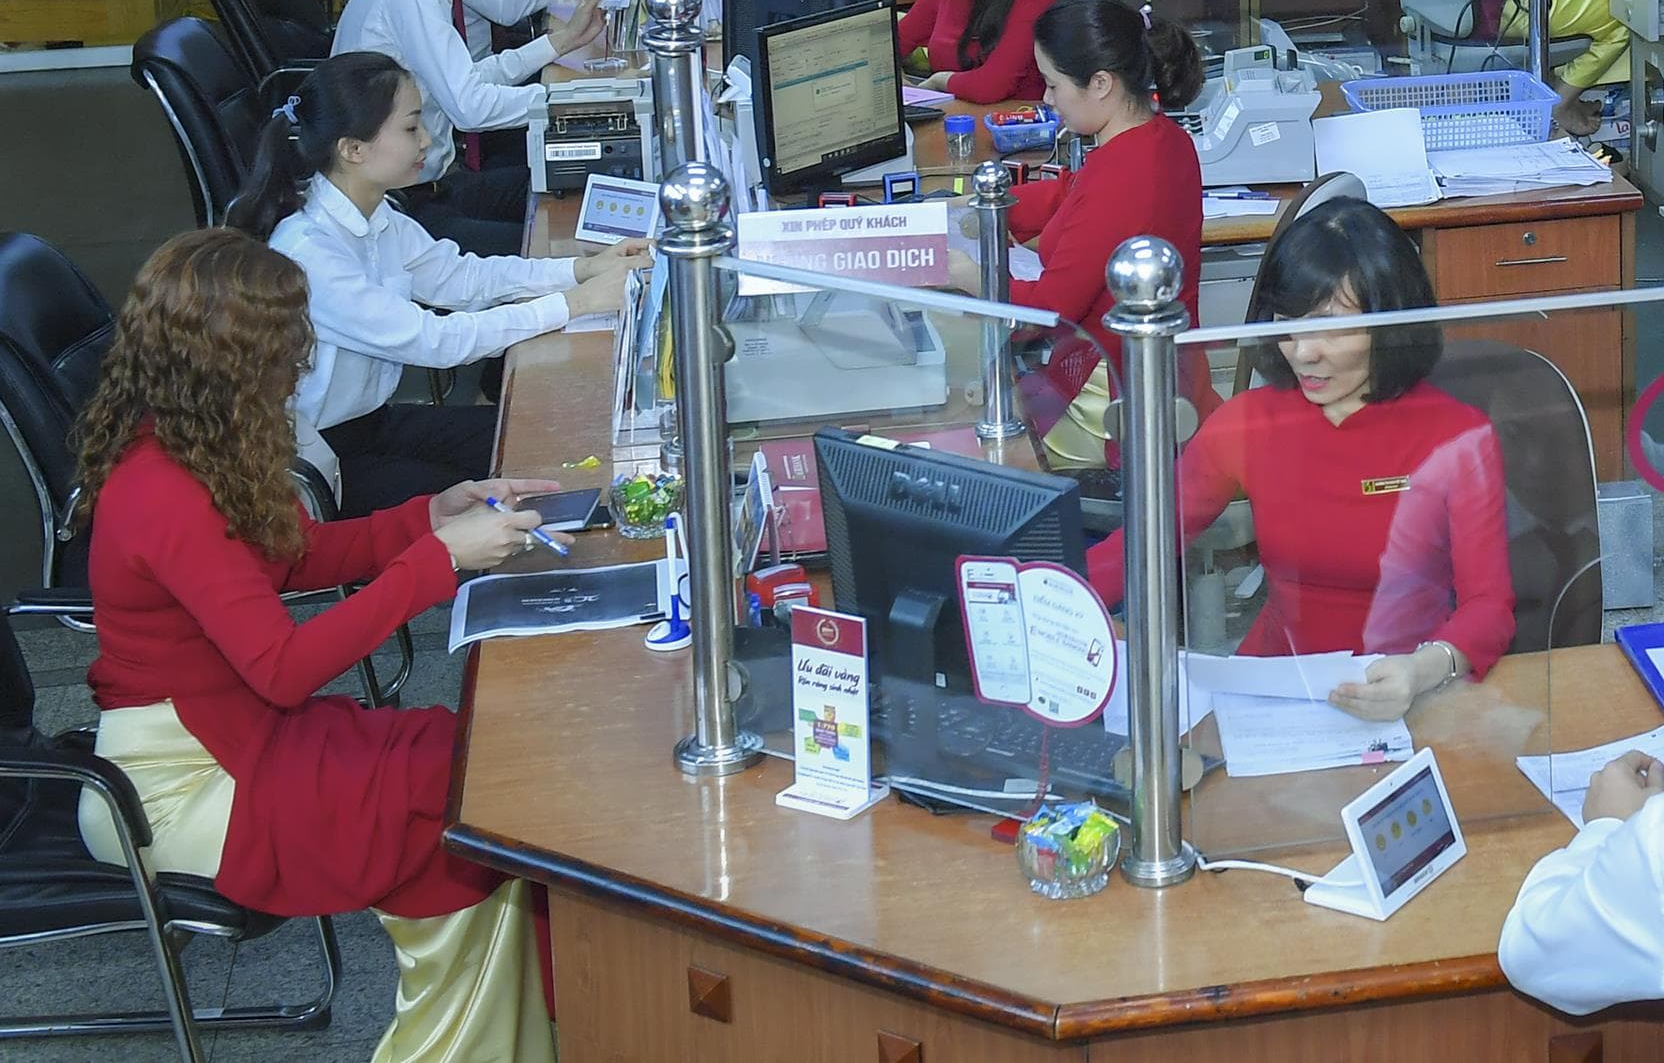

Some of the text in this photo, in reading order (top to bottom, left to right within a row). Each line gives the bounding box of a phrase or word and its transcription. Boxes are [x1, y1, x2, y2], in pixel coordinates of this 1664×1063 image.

[806, 218, 836, 232] PHÉP
[840, 217, 863, 230] QUÝ
[867, 216, 907, 229] KHÁCH
[834, 251, 880, 271] GIAO
[887, 248, 934, 271] DỊCH
[834, 668, 860, 685] vàng
